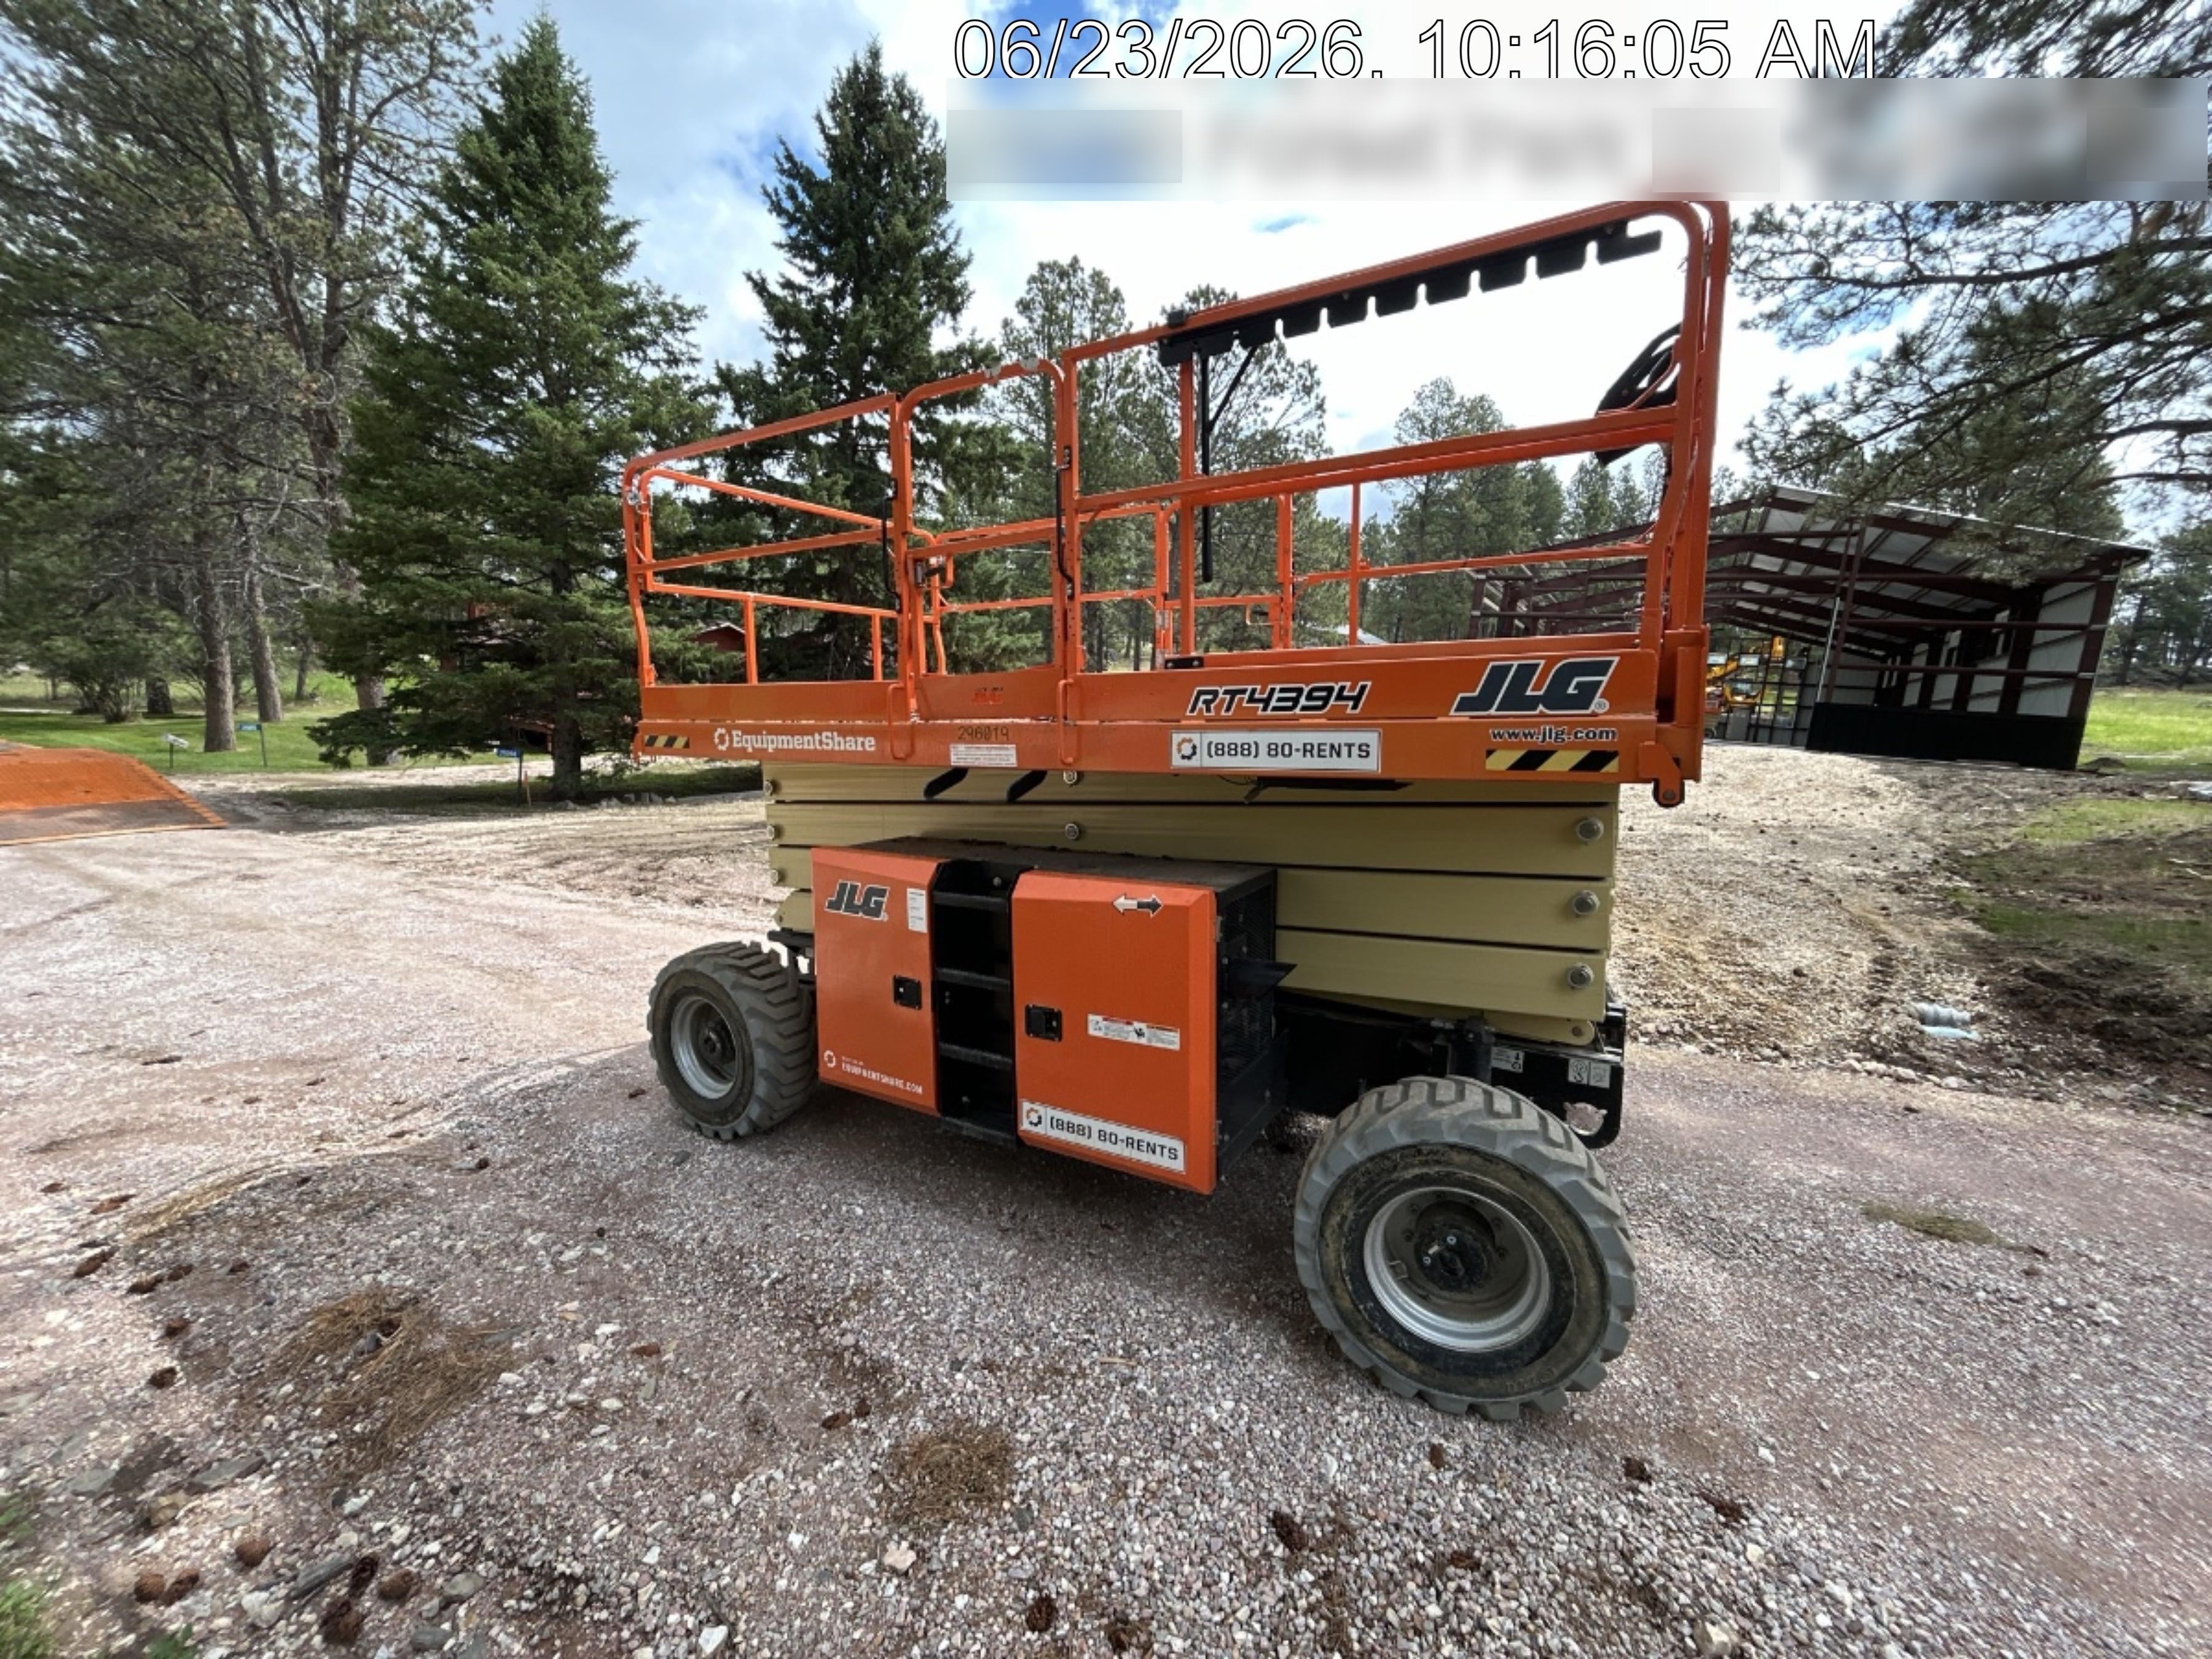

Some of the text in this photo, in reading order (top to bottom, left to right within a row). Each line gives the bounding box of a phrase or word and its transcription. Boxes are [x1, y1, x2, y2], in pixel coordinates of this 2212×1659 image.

[1185, 681, 1372, 715] RT4394
[1449, 656, 1620, 716] JLG
[731, 729, 876, 753] EquipmentShare
[1206, 740, 1371, 759] (888) 80-RENTS
[1489, 725, 1618, 744] www.jlg.com
[824, 879, 890, 921] JLG
[1049, 1115, 1179, 1161] (888) 80-RENTS
